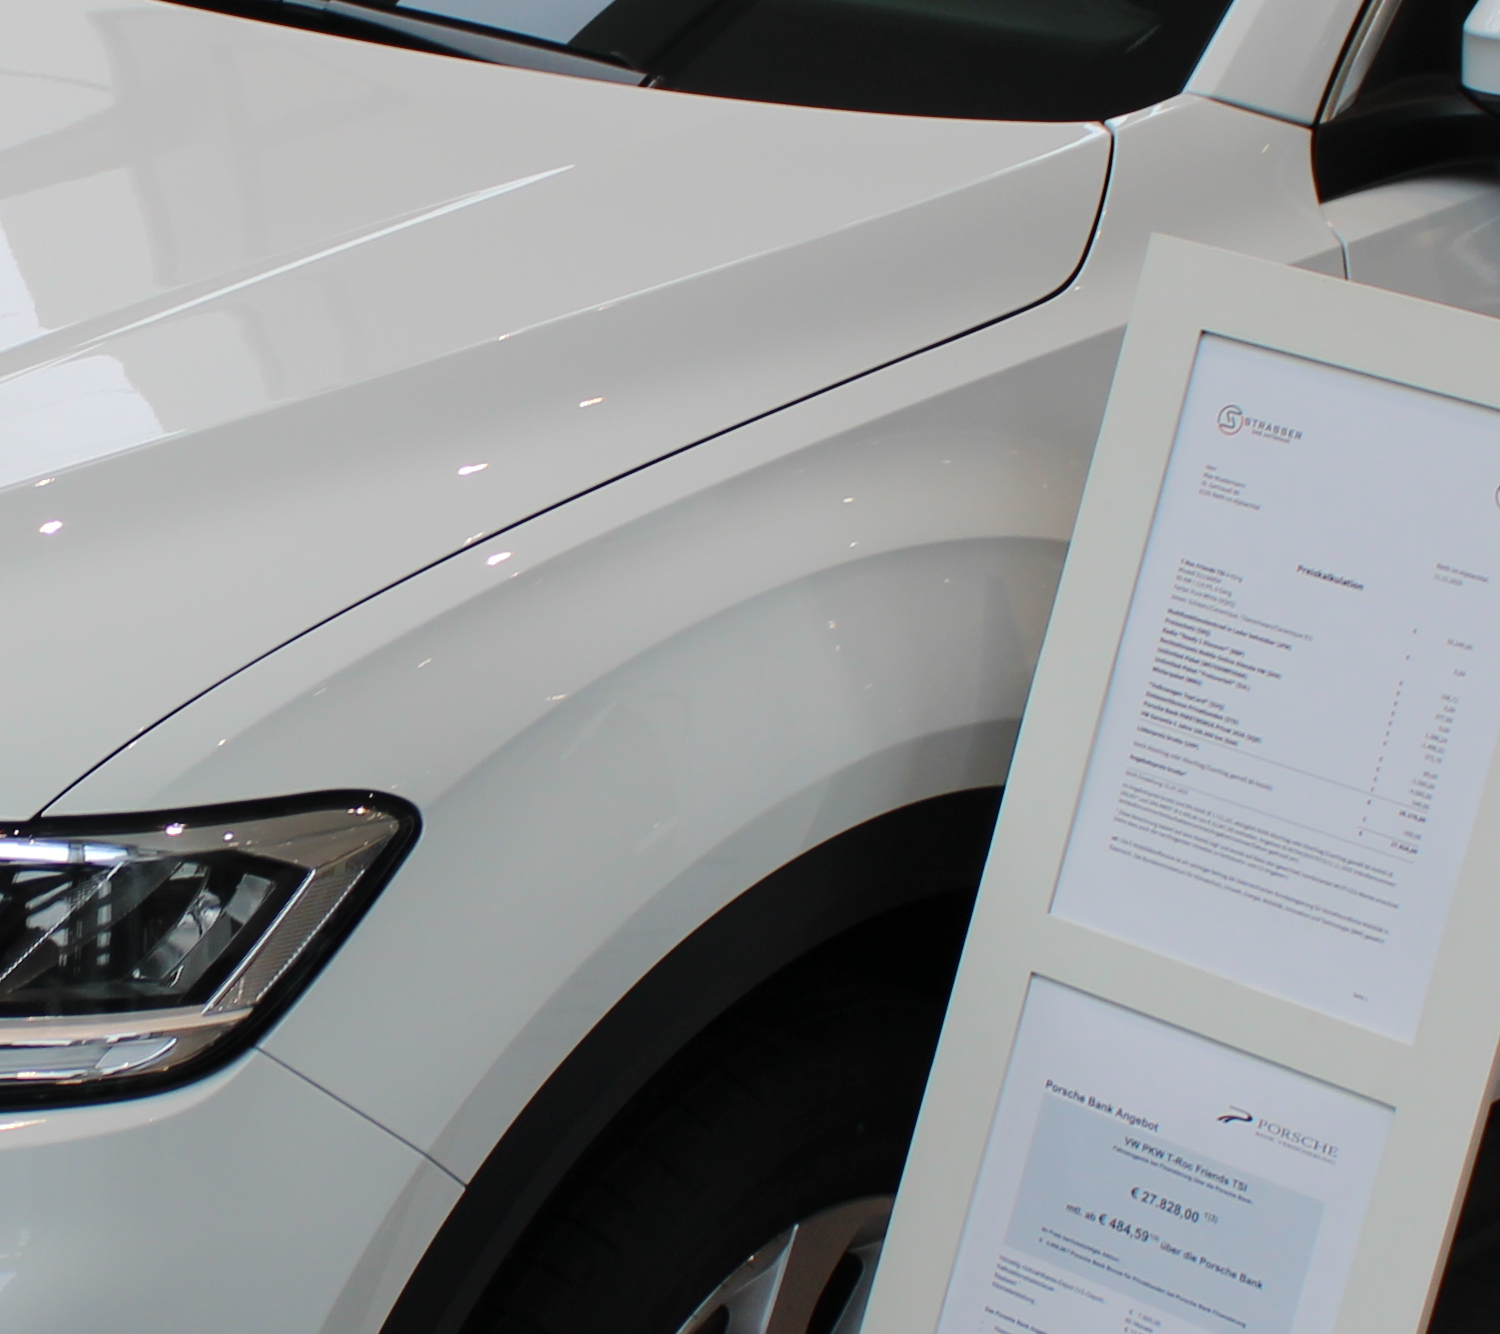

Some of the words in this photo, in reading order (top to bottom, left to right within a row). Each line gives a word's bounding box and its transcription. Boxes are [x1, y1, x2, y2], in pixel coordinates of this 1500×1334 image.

[1243, 416, 1303, 440] STRASSER
[1295, 564, 1365, 592] Preiskalkulation
[1044, 1079, 1086, 1104] Porsche
[1086, 1095, 1114, 1115] Bank
[1114, 1106, 1159, 1135] Angebot
[1256, 1117, 1339, 1158] PORSCHE
[1122, 1135, 1141, 1151] VW
[1141, 1142, 1165, 1160] PKW
[1165, 1152, 1194, 1172] T-Roc
[1194, 1163, 1230, 1186] Friends
[1230, 1177, 1249, 1193] TSI
[1129, 1185, 1140, 1200] €
[1139, 1189, 1200, 1226] 27.828,00
[1065, 1201, 1083, 1217] mtl.
[1083, 1209, 1096, 1223] ab
[1097, 1211, 1108, 1226] €
[1159, 1240, 1181, 1257] über
[1181, 1249, 1198, 1264] die
[1198, 1256, 1238, 1280] Porsche
[1238, 1272, 1263, 1291] Bank
